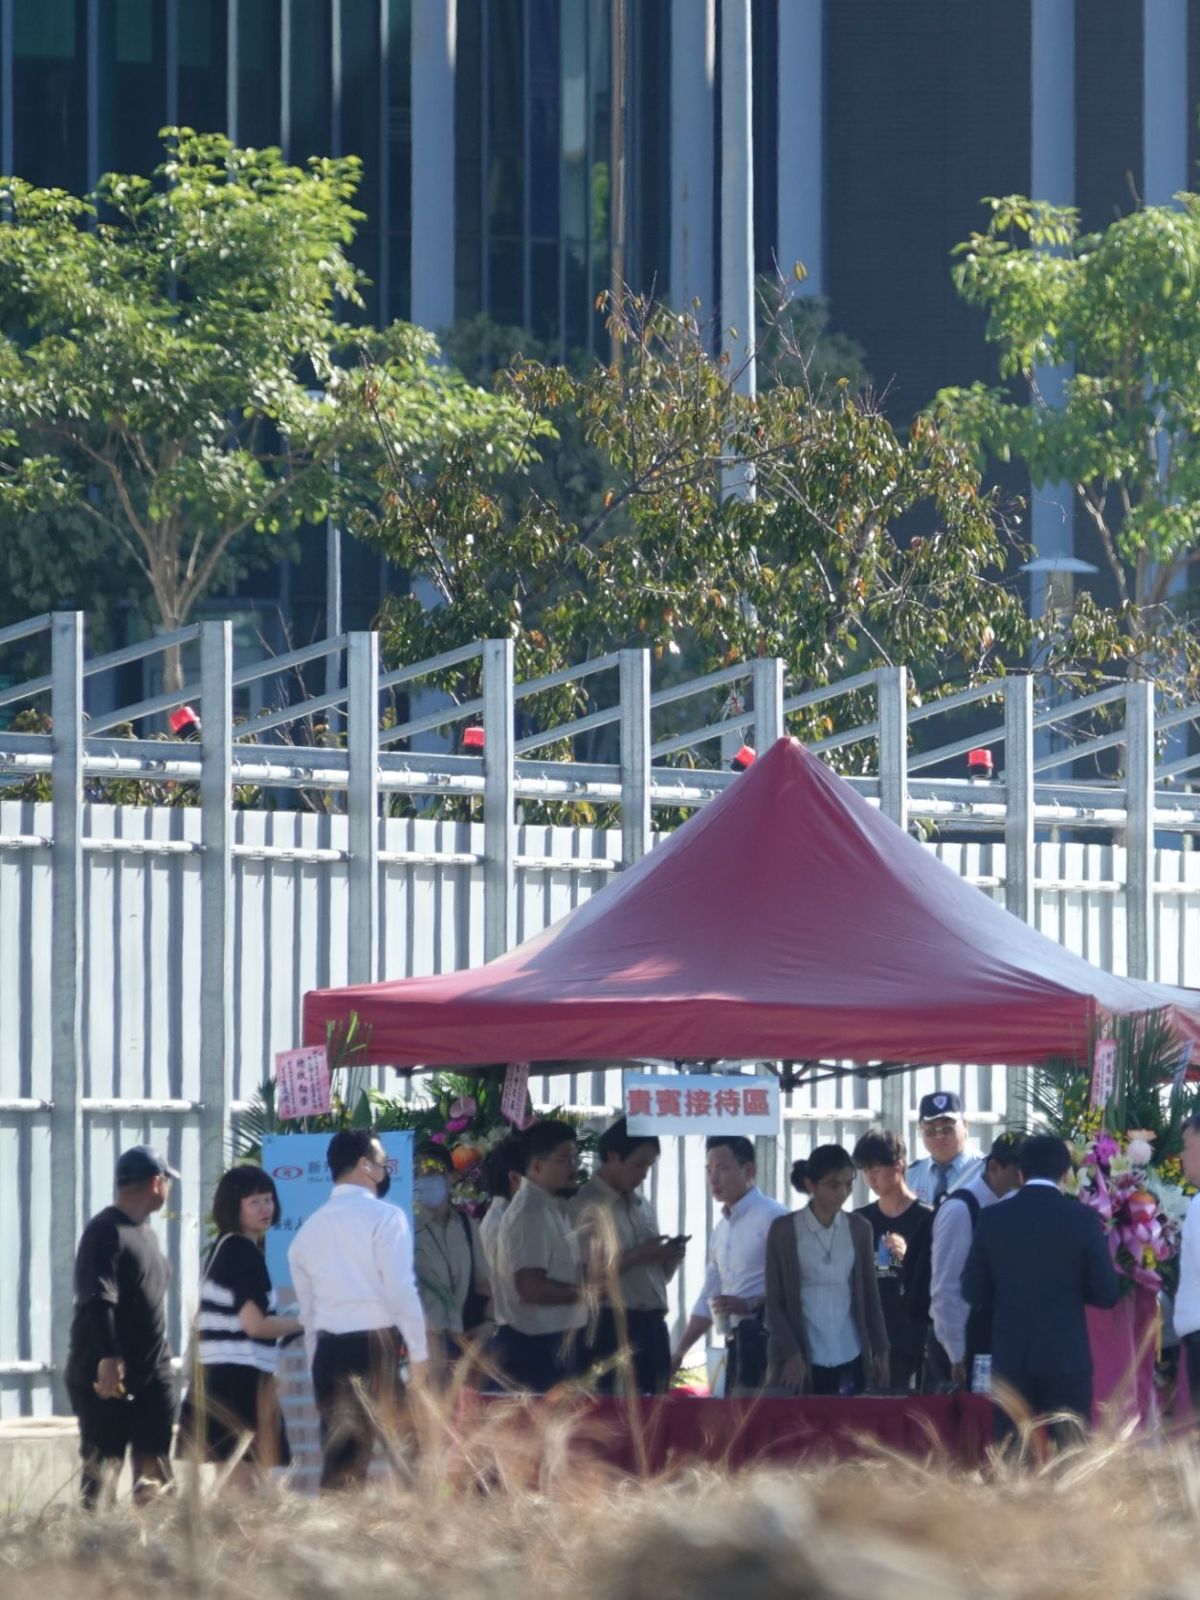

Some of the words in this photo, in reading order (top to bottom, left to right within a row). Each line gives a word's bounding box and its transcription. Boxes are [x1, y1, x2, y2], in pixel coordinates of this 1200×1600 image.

[627, 1088, 770, 1117] 貴賓接待區
